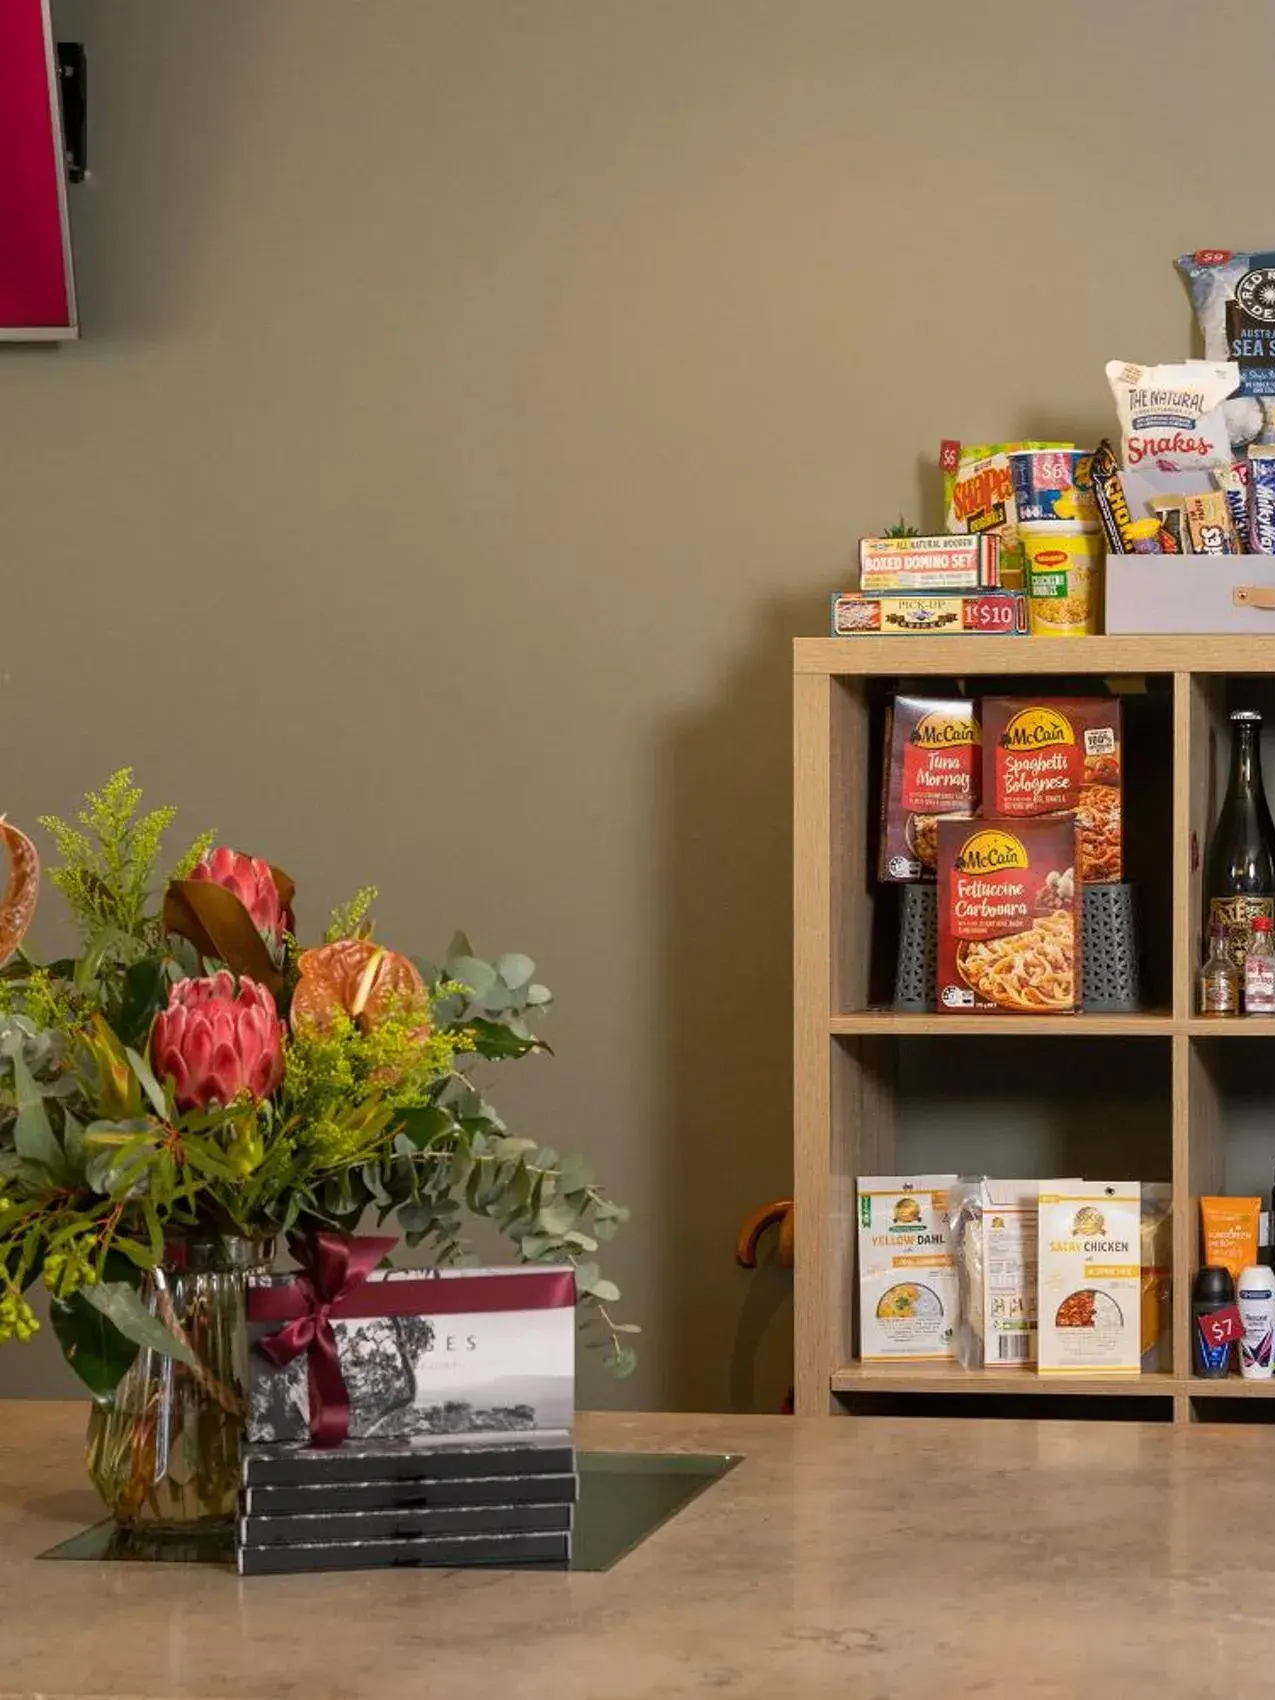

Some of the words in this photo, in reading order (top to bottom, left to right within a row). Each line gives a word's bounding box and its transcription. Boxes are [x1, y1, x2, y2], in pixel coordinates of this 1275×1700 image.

[1232, 340, 1264, 357] SEA
[1150, 389, 1205, 412] NATURAL
[1127, 431, 1214, 465] Snakes
[864, 556, 902, 572] BOXED
[904, 555, 950, 571] DOMINO
[951, 553, 974, 568] SET
[980, 606, 1012, 624] $10
[923, 721, 975, 744] McCain
[1013, 721, 1065, 745] McCain
[927, 750, 961, 771] Tuna
[1004, 753, 1068, 776] Spaghetti
[916, 769, 971, 794] Mornay
[1003, 772, 1071, 796] Bolognese
[966, 845, 1020, 869] McCain
[958, 879, 1025, 898] Fettuccine
[955, 898, 1028, 918] Carbonara
[871, 1234, 916, 1246] YELLOW
[917, 1233, 946, 1245] DAHL
[1084, 1241, 1129, 1252] CHICKEN
[1211, 1318, 1233, 1342] $7
